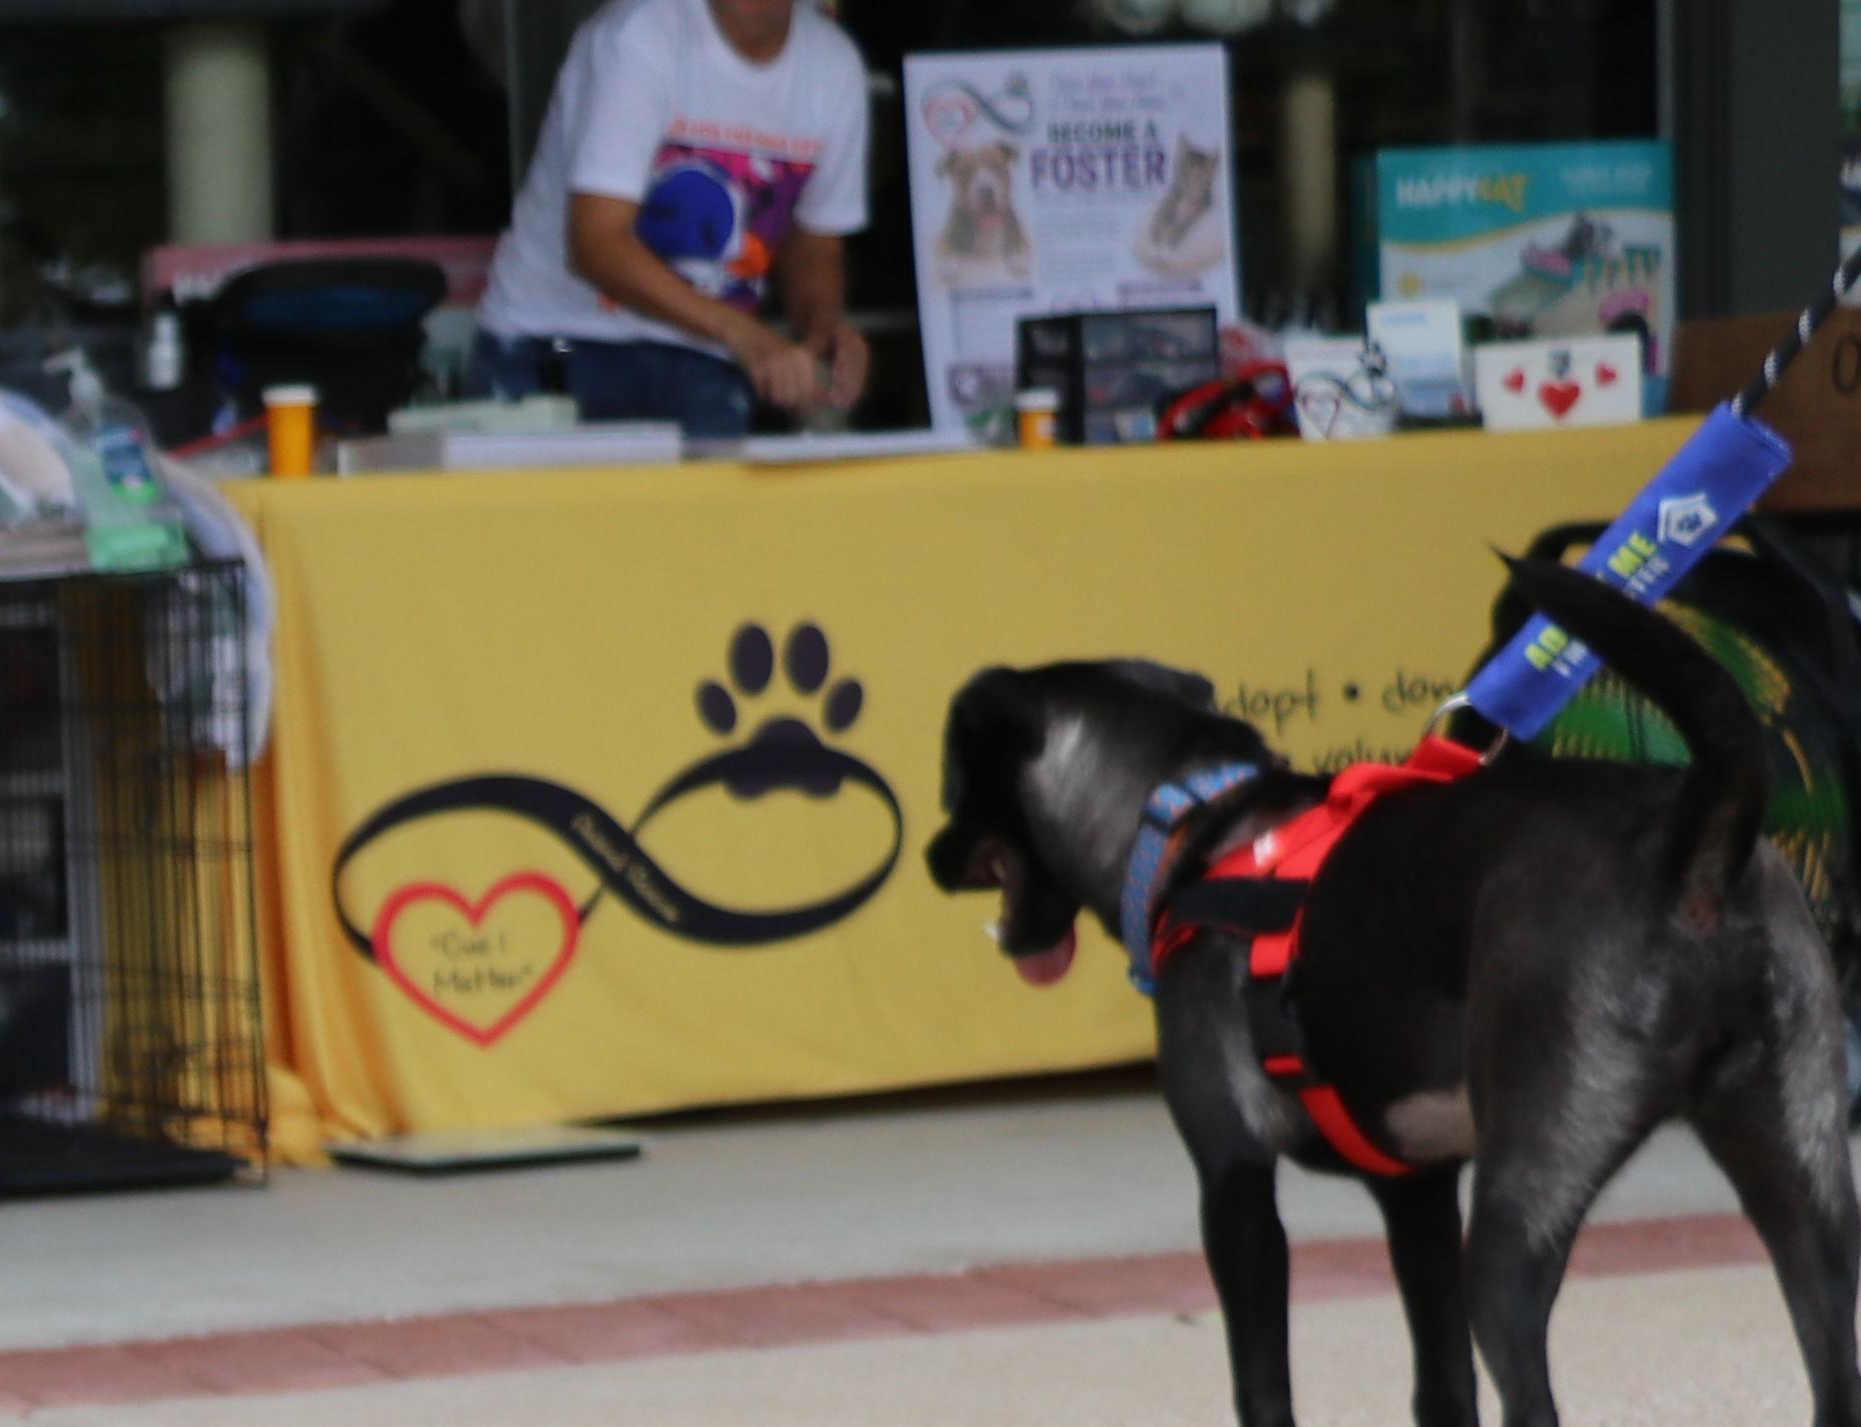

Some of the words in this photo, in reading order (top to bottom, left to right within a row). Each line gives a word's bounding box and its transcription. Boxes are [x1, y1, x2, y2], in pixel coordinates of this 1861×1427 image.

[1145, 119, 1160, 140] A
[1030, 147, 1166, 189] FOSTER
[1223, 666, 1317, 737] dopt
